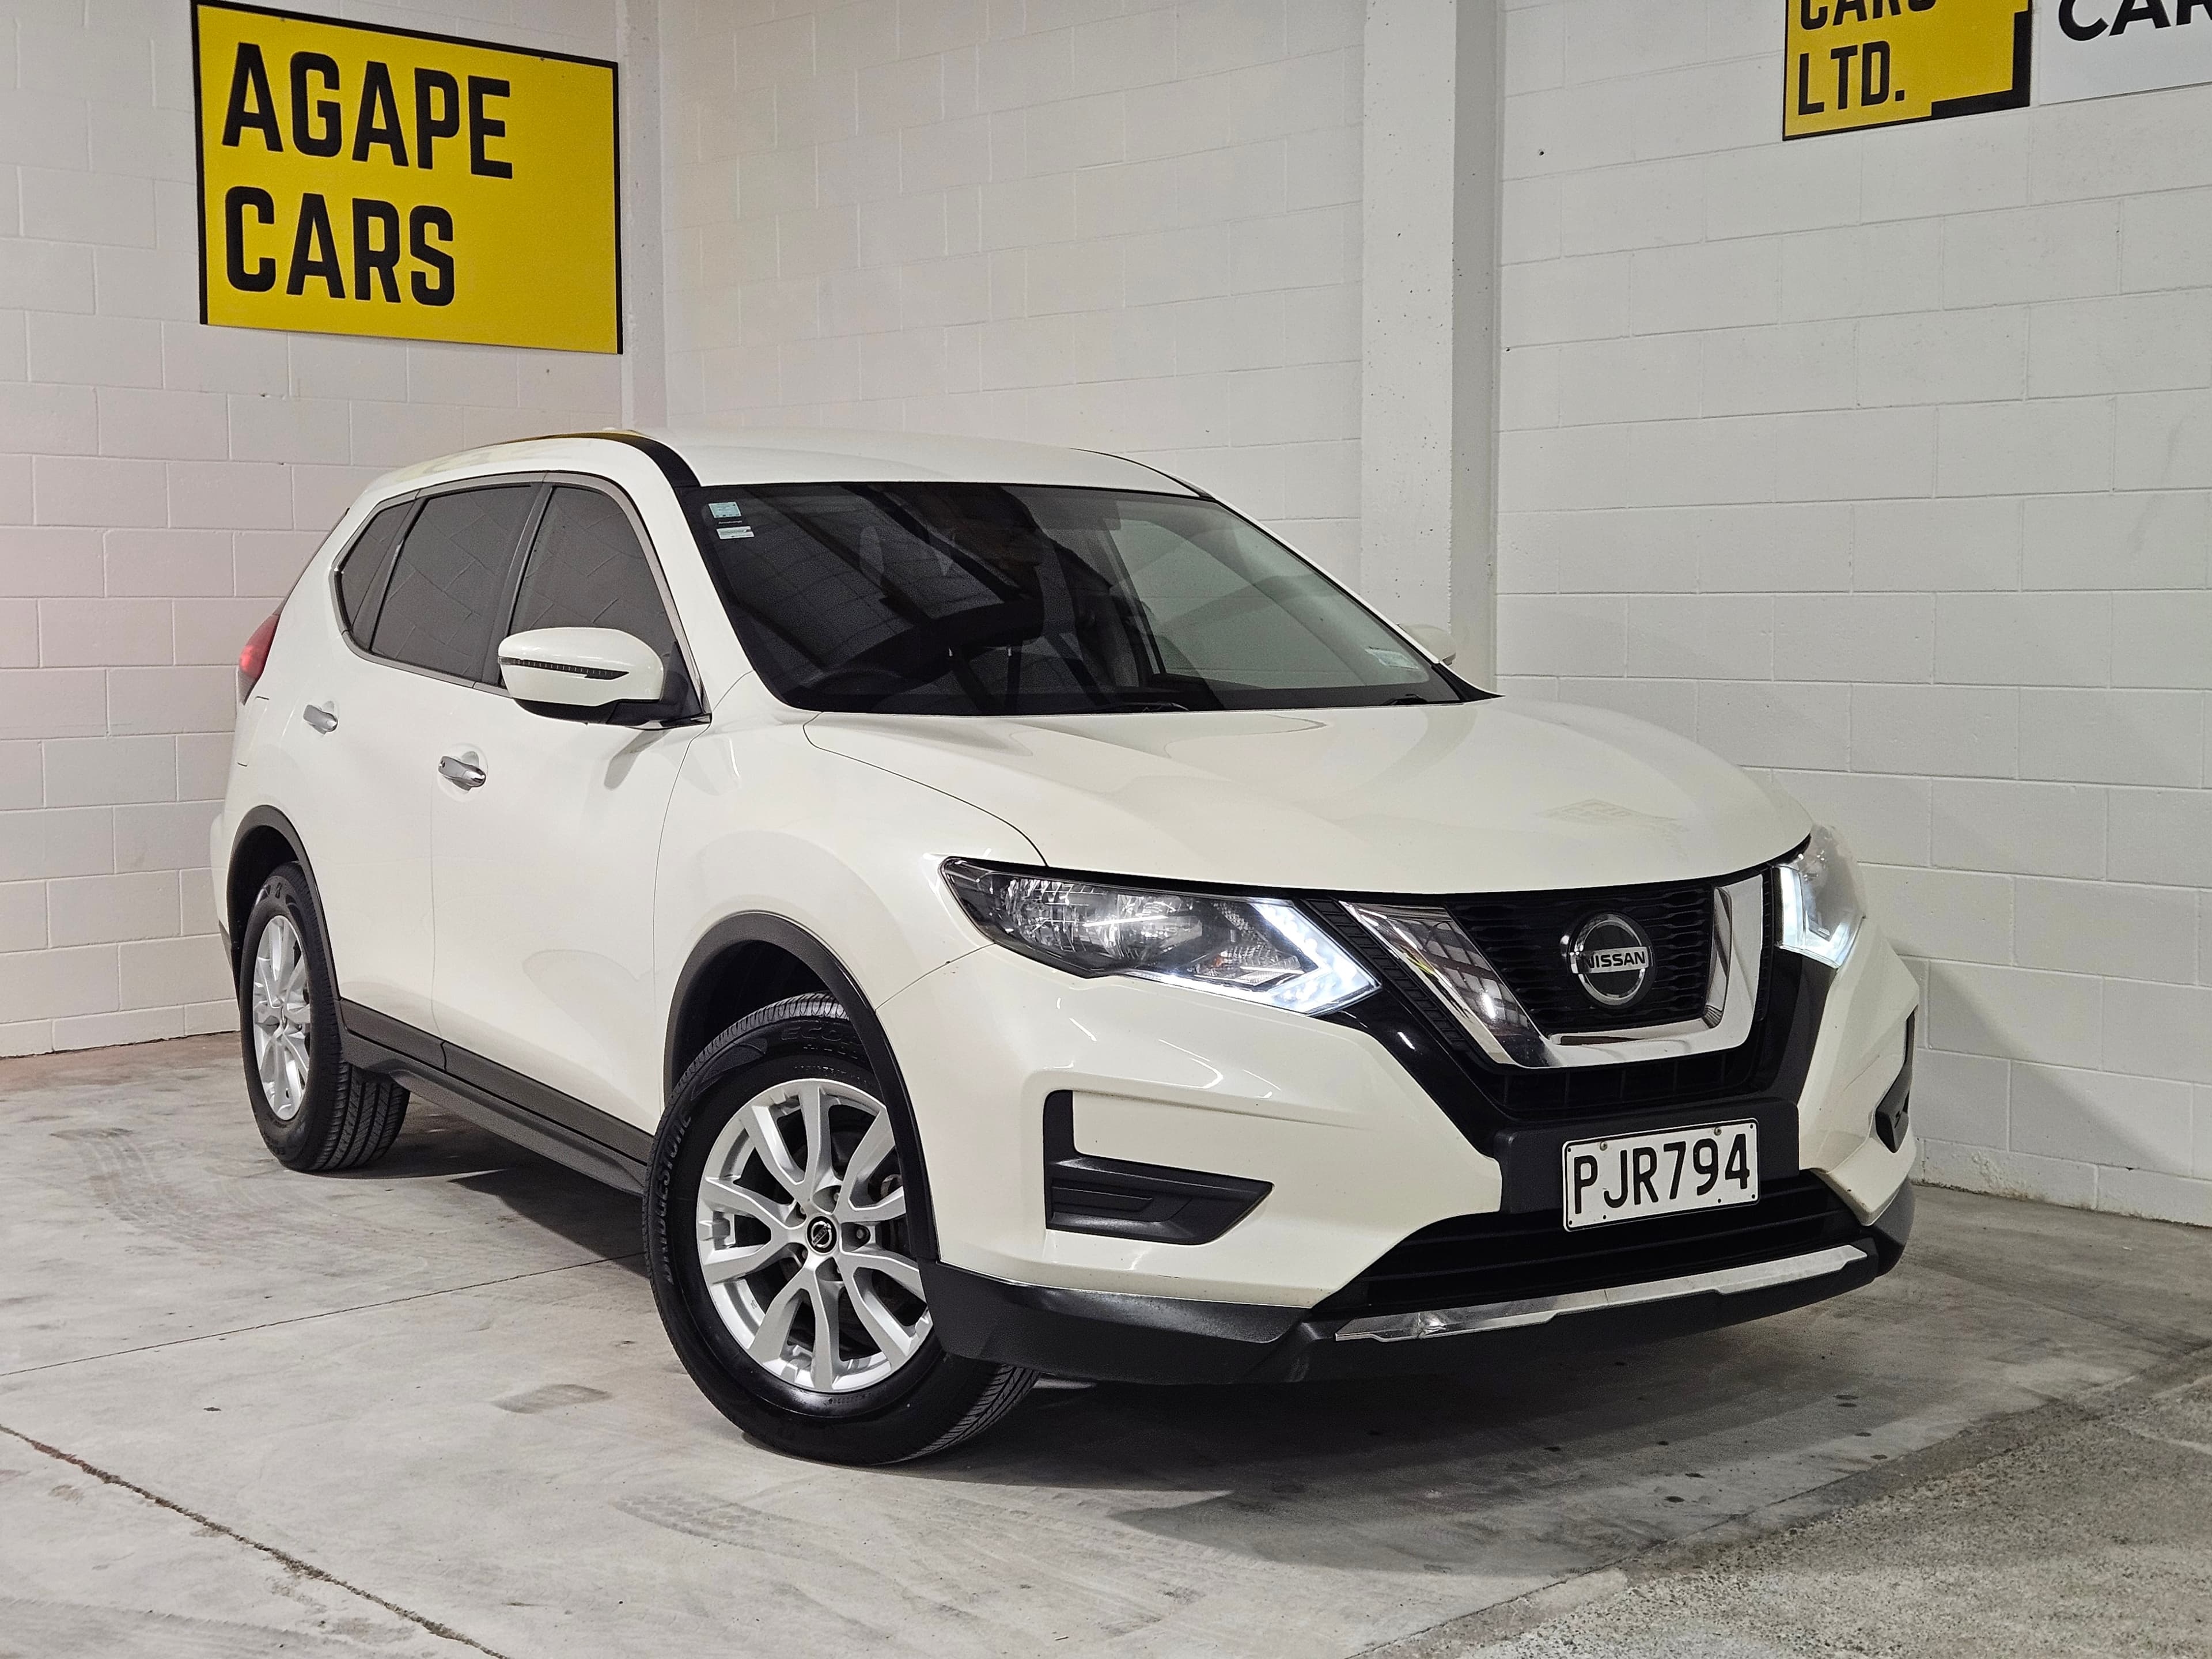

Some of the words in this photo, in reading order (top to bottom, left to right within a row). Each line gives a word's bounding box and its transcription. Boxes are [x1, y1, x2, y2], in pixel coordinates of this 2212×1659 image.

[1801, 0, 1936, 30] CA
[222, 41, 513, 180] AGAPE
[1798, 40, 1905, 116] LTD.
[225, 185, 455, 307] CARS
[1586, 951, 1646, 969] NISSAN
[1573, 1133, 1750, 1214] PJR794
